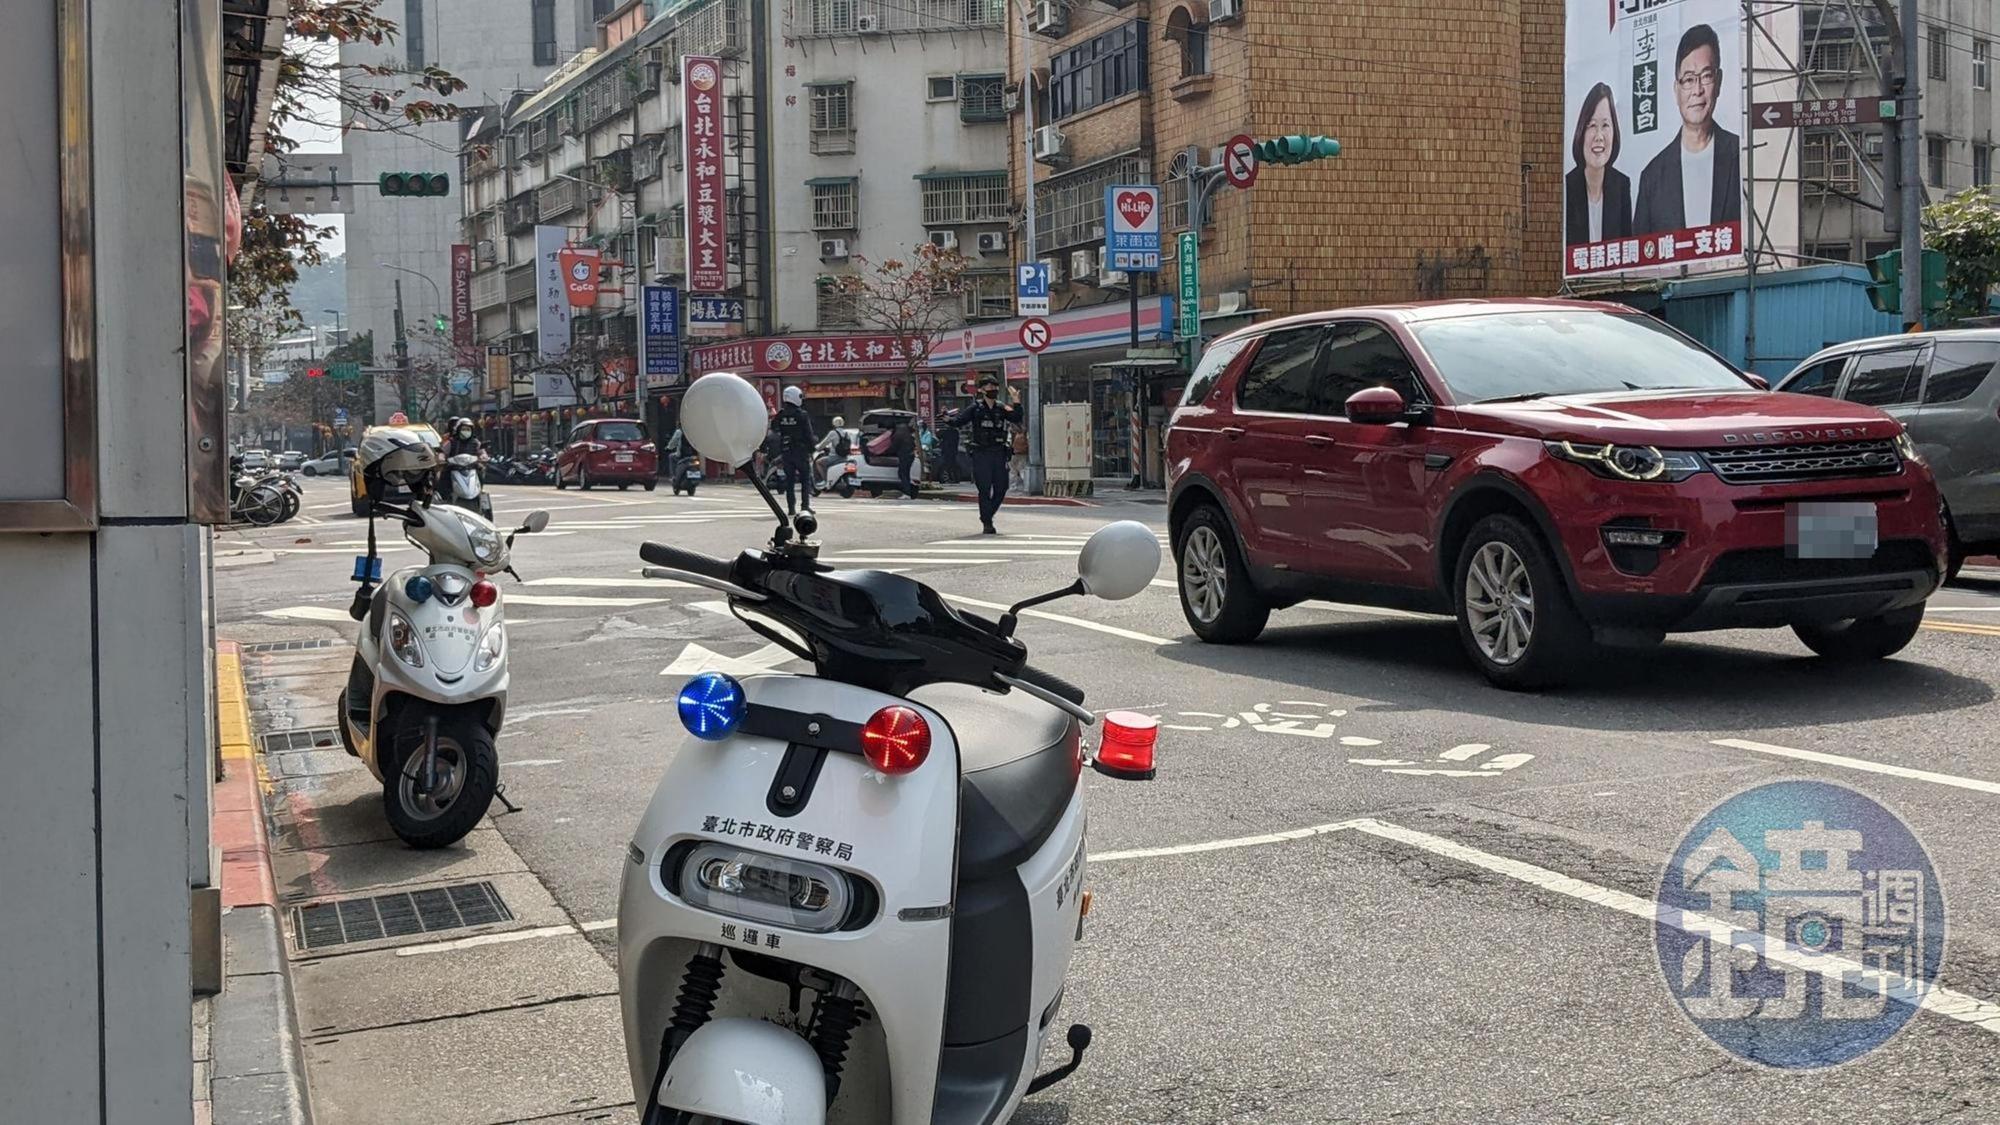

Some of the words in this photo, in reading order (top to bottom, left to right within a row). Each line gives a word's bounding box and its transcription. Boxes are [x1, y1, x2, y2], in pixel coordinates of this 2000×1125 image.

[1634, 28, 1656, 131] 李建昌
[694, 93, 719, 268] 台北永和豆漿大王
[1121, 199, 1151, 218] Hi-Life
[1115, 234, 1158, 248] 萊爾富
[1573, 240, 1640, 270] 電話民調
[1658, 227, 1733, 260] 唯一支持
[1020, 266, 1036, 286] P
[1184, 242, 1194, 297] 內湖路三段
[456, 270, 467, 324] SAKURA
[570, 283, 594, 292] CoCo
[1723, 427, 1868, 443] DISCOVERY
[701, 815, 853, 861] 臺北市政府警察局
[720, 923, 782, 949] 巡邏車
